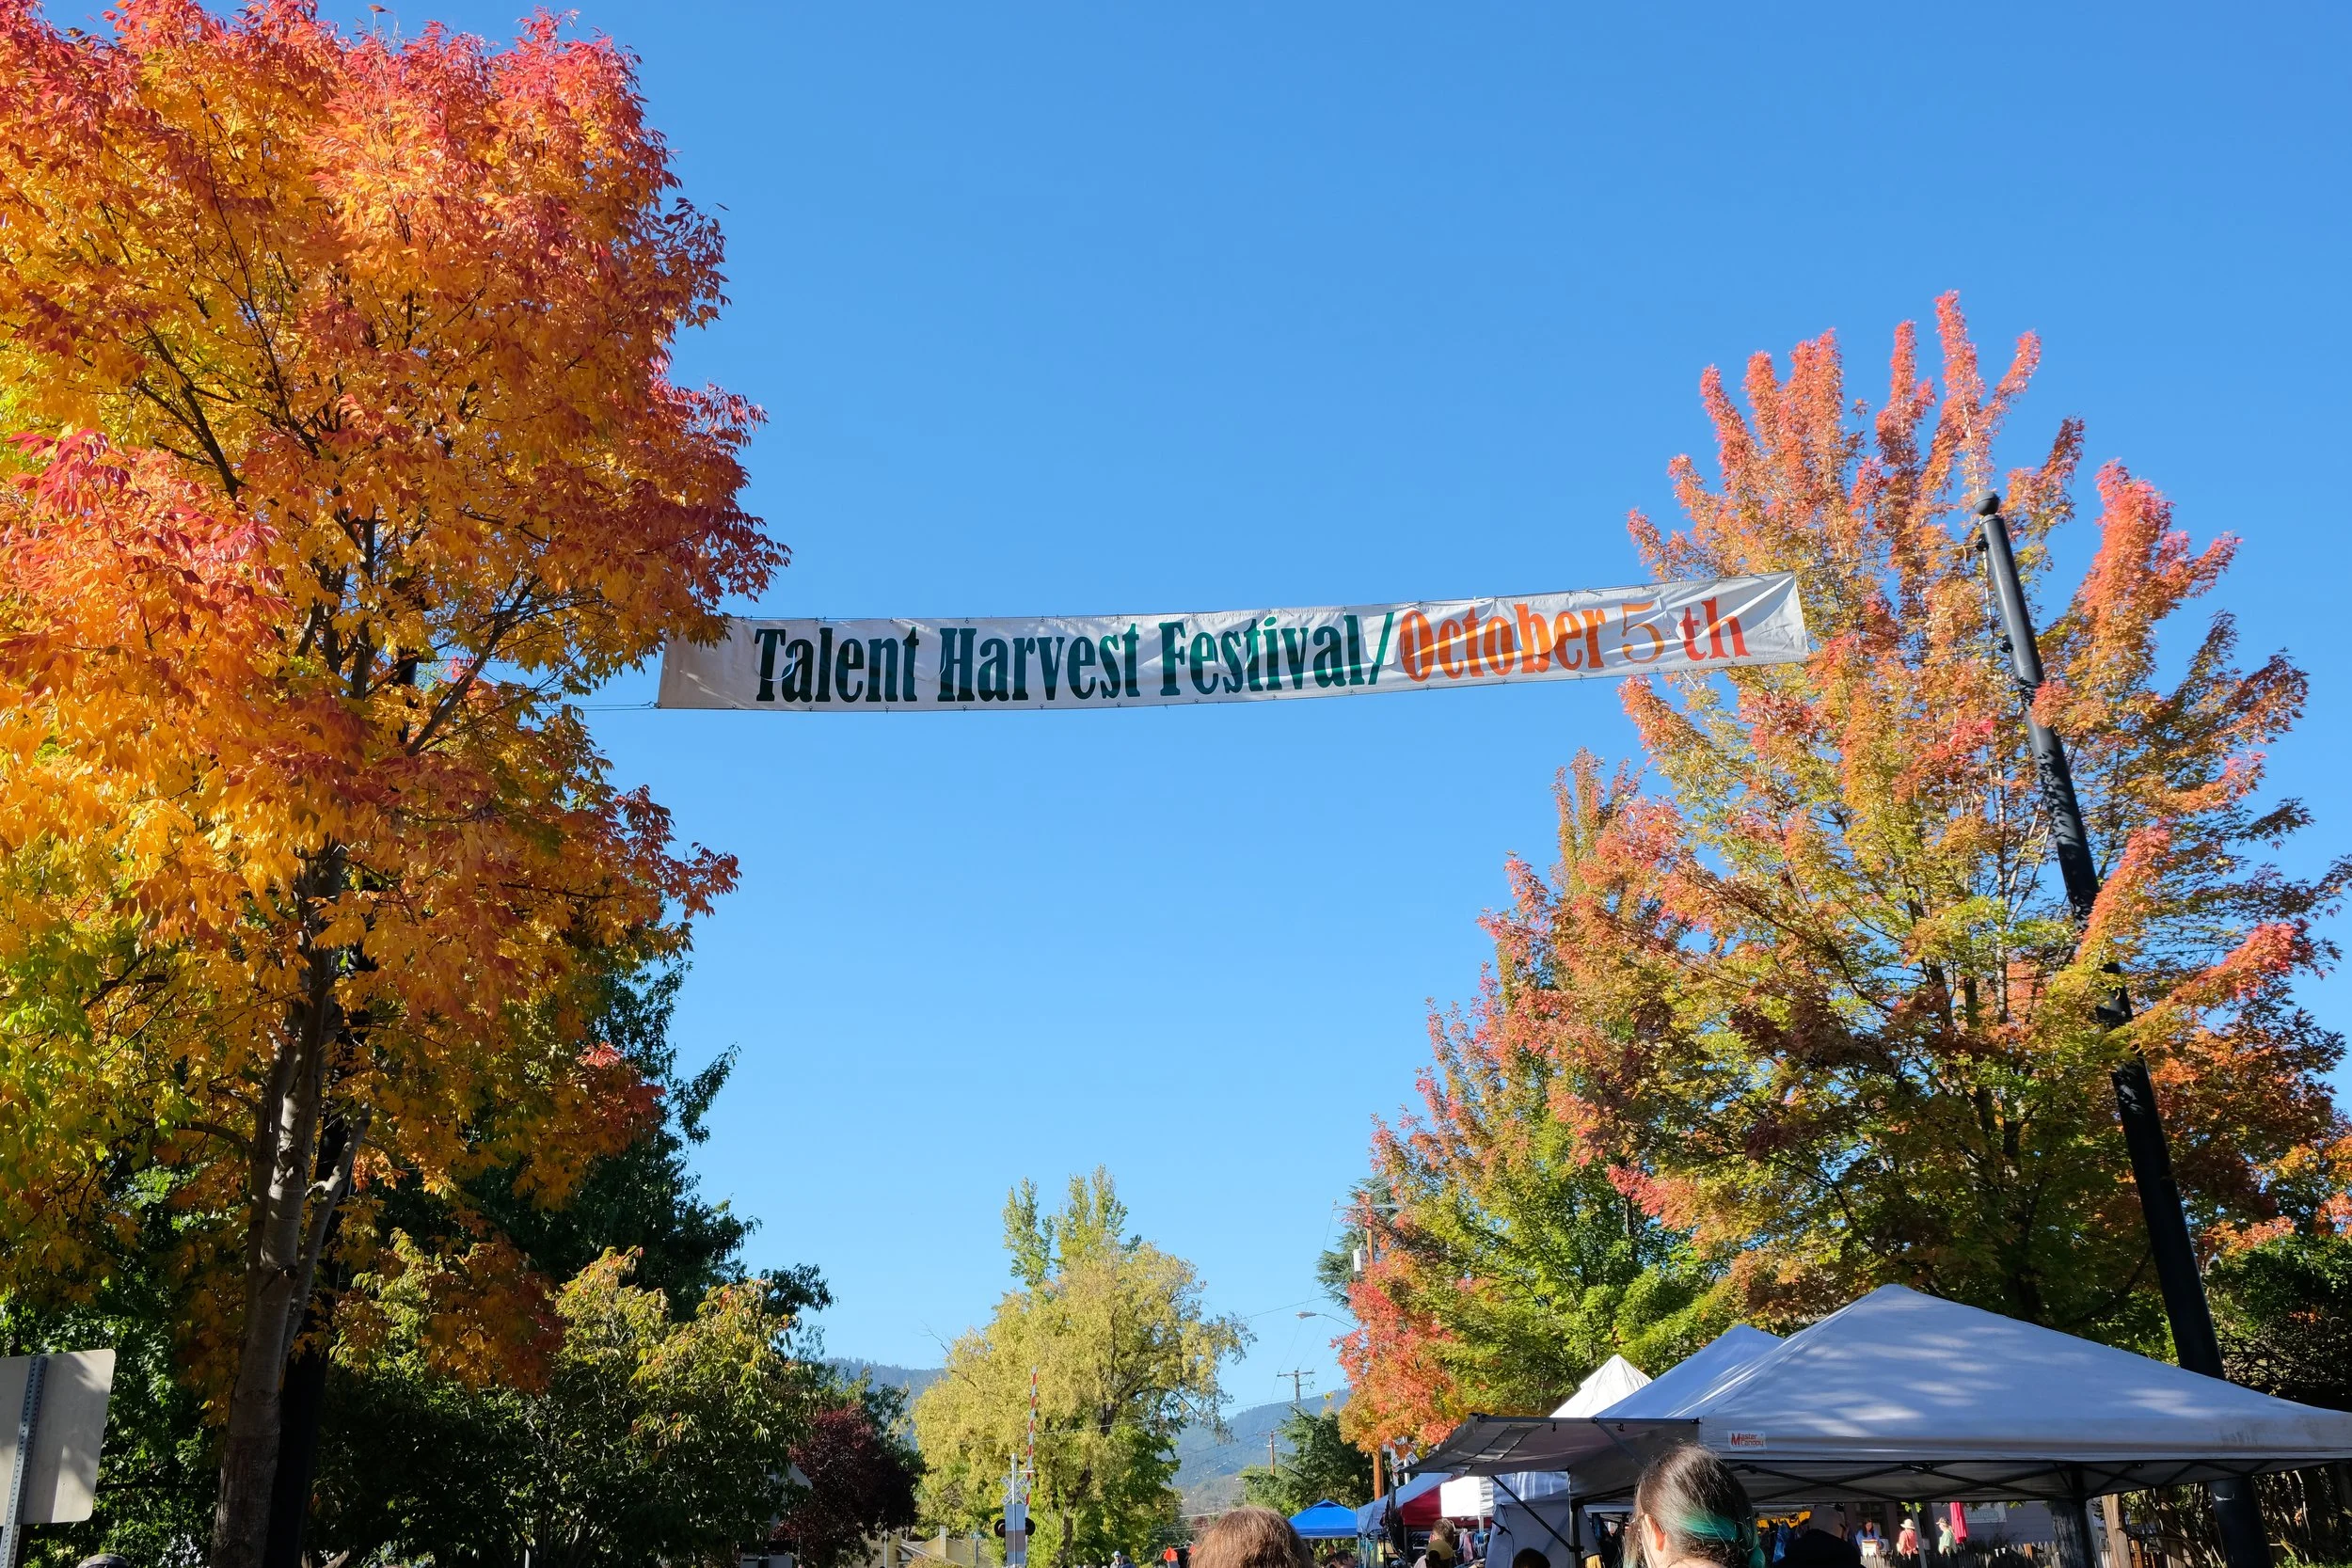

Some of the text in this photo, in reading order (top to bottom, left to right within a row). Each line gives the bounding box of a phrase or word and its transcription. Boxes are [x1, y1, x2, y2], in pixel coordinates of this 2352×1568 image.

[754, 626, 920, 703] Talent
[937, 622, 1140, 703] Harvest
[1621, 600, 1665, 664] 5
[1679, 596, 1752, 661] th
[1731, 1433, 1757, 1446] Master
